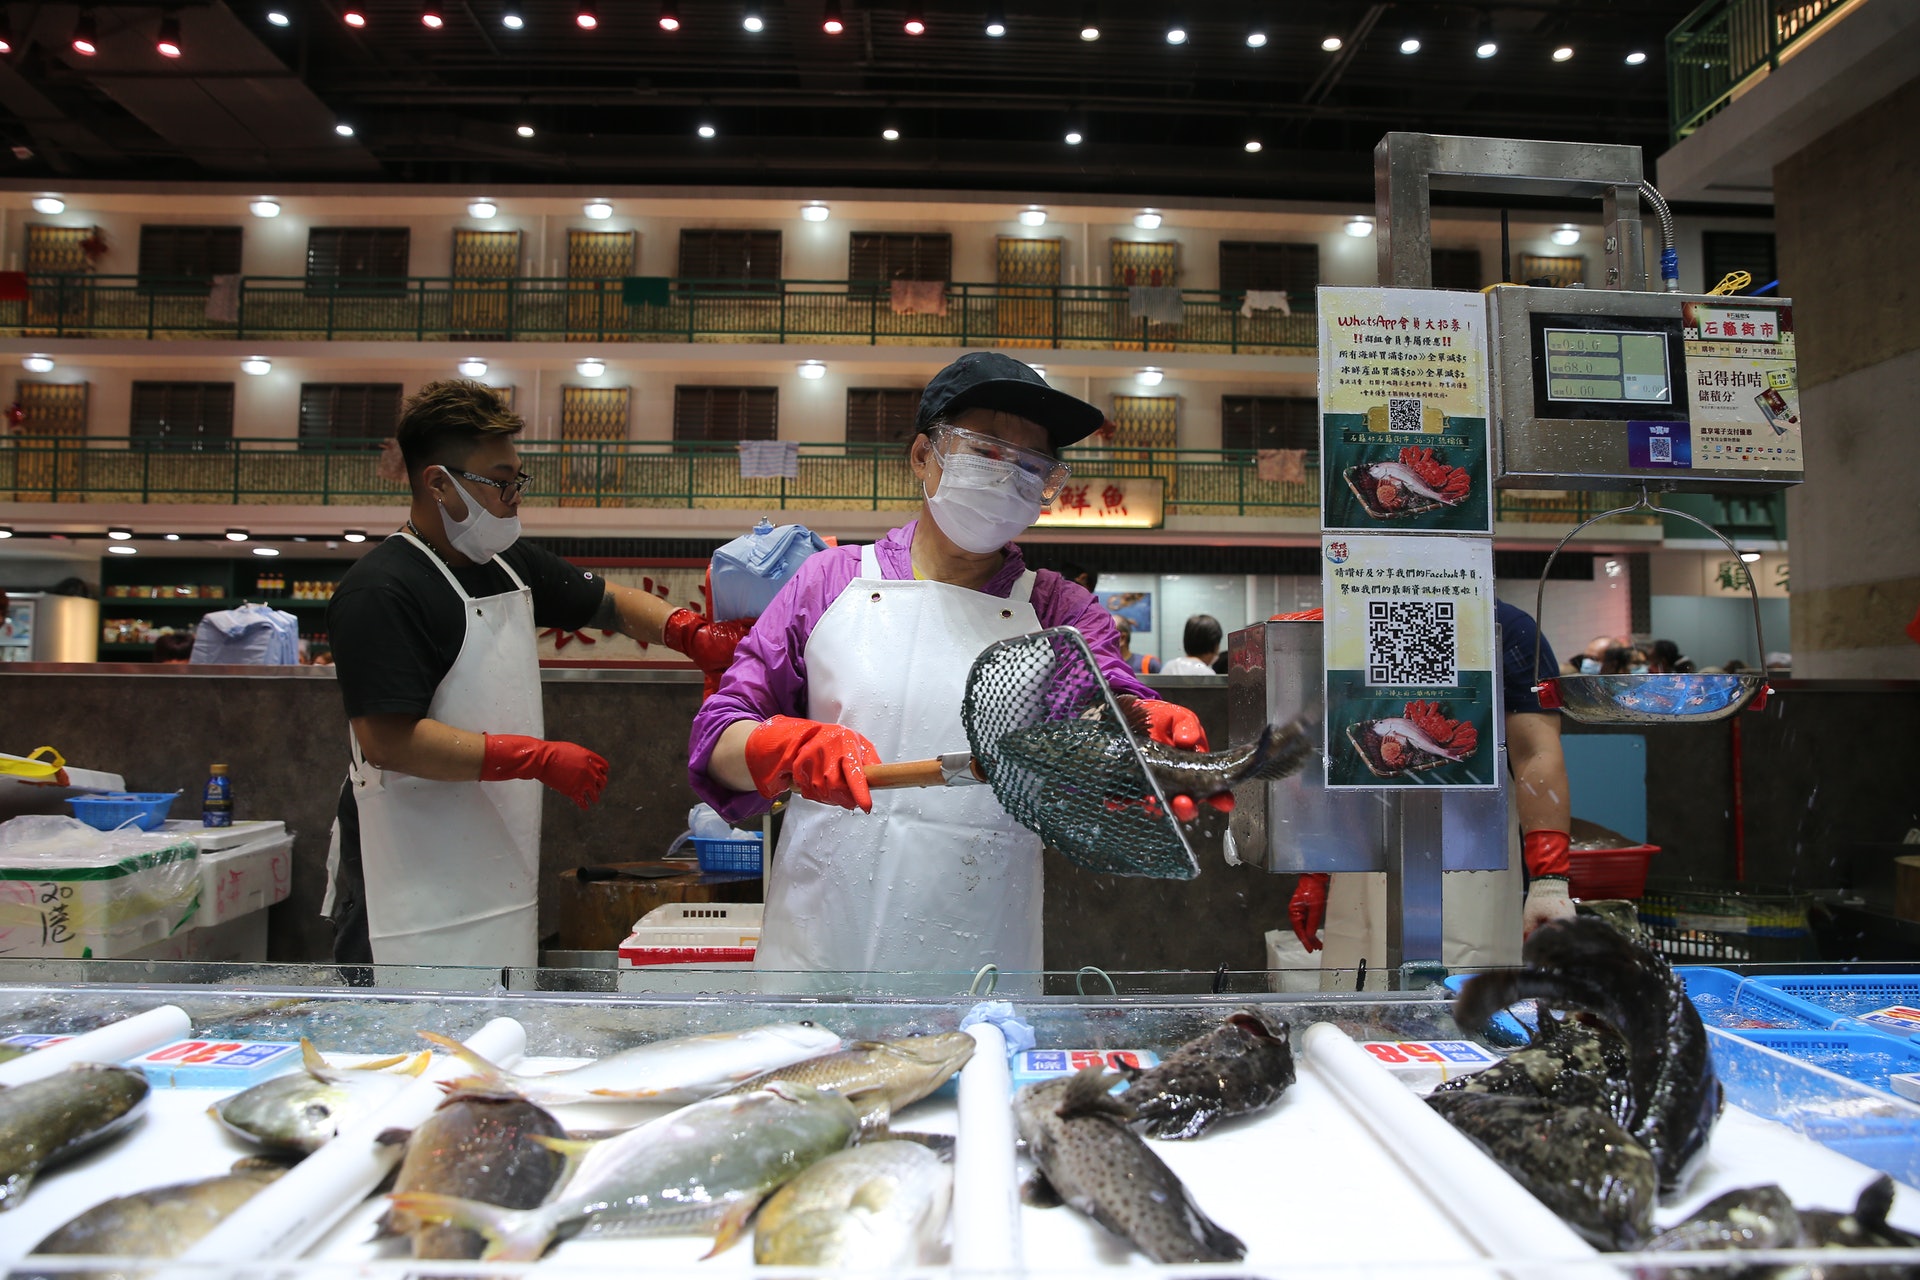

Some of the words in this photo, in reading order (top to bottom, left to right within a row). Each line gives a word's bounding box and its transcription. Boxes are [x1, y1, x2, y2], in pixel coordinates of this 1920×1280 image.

[1697, 370, 1762, 387] 記得拍咭
[1041, 484, 1128, 517] 鮮魚
[40, 882, 74, 904] 20
[146, 1042, 243, 1063] 30
[1071, 1051, 1140, 1072] 50
[1364, 1043, 1446, 1063] 58
